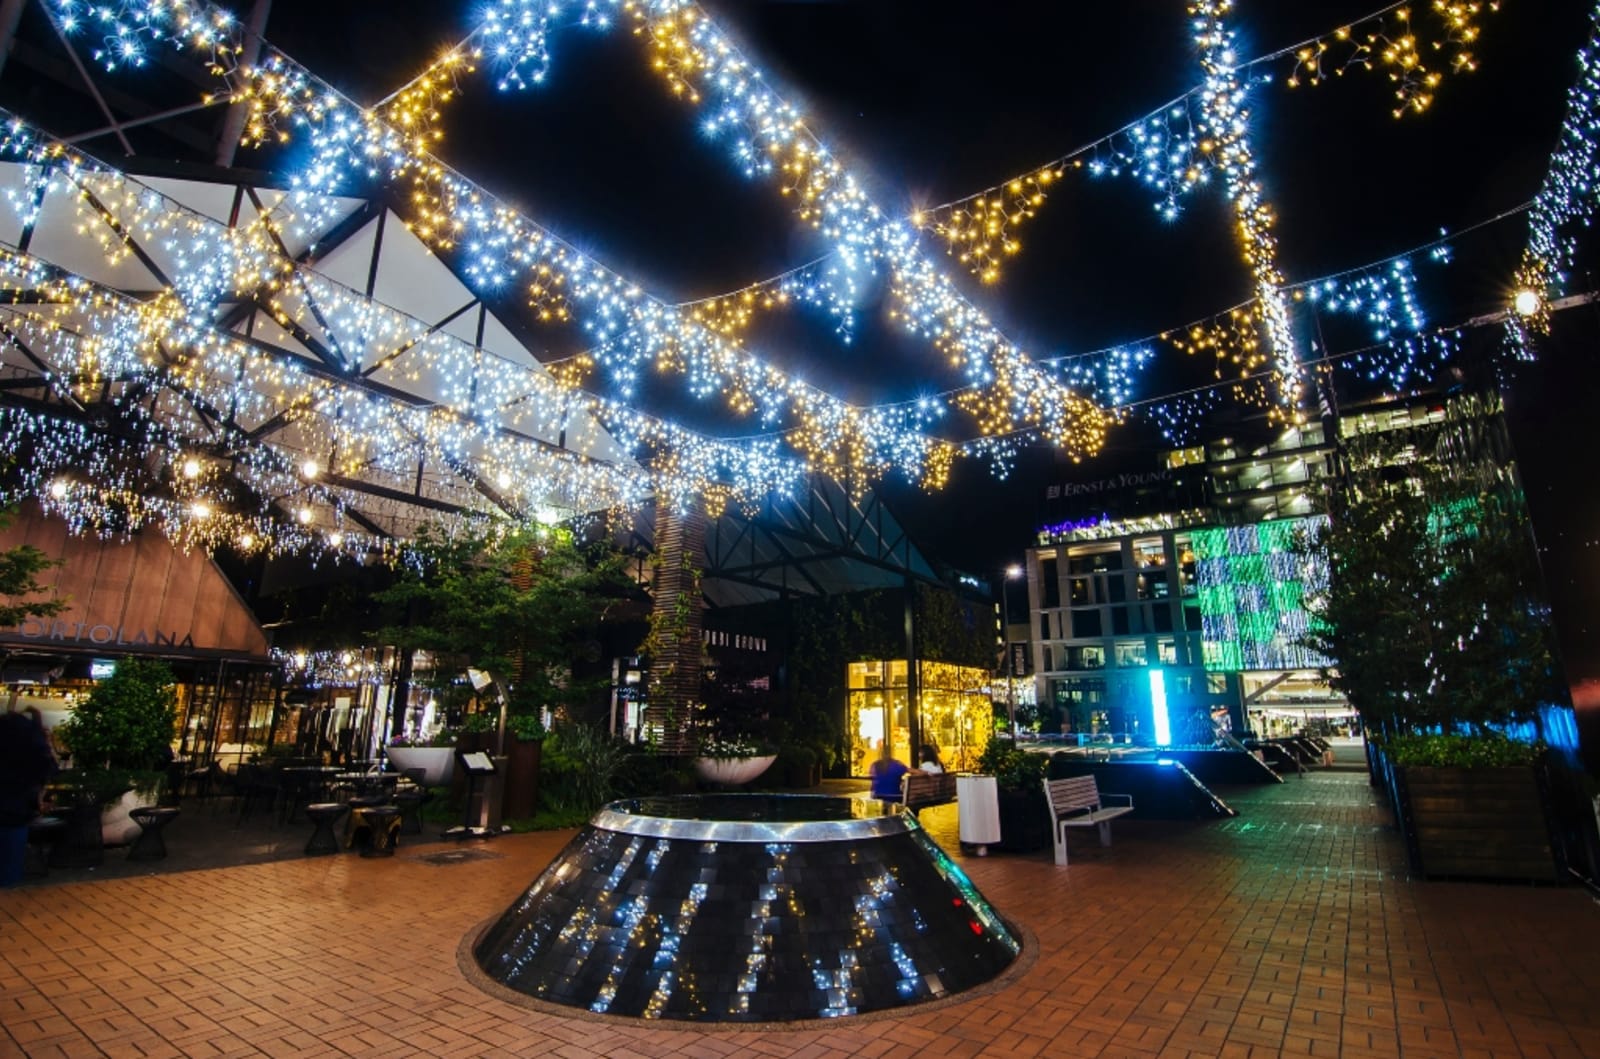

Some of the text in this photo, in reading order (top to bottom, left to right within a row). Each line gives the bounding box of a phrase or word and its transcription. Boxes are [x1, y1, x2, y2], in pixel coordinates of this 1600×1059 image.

[1064, 480, 1104, 497] ERNST
[1107, 478, 1117, 489] &
[1119, 471, 1172, 487] YOUNG
[20, 619, 195, 648] ORTOLANA
